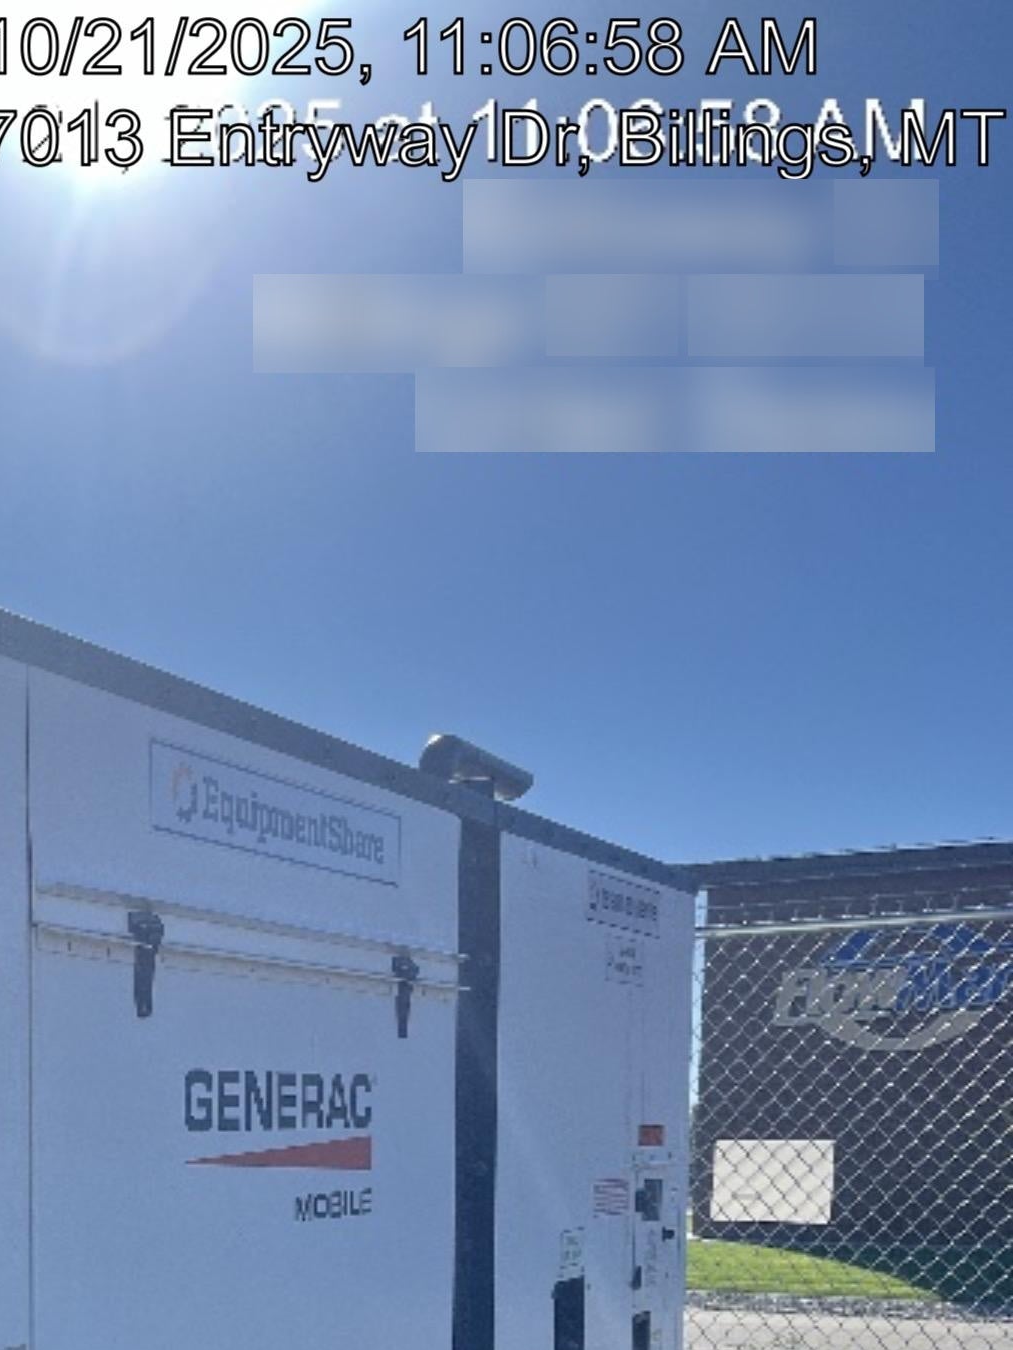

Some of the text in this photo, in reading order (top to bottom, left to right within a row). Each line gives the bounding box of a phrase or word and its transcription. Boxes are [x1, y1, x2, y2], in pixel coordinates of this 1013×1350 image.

[203, 775, 385, 865] EquipmentShare
[185, 1069, 372, 1131] GENERAC
[294, 1188, 372, 1221] MOBILE
